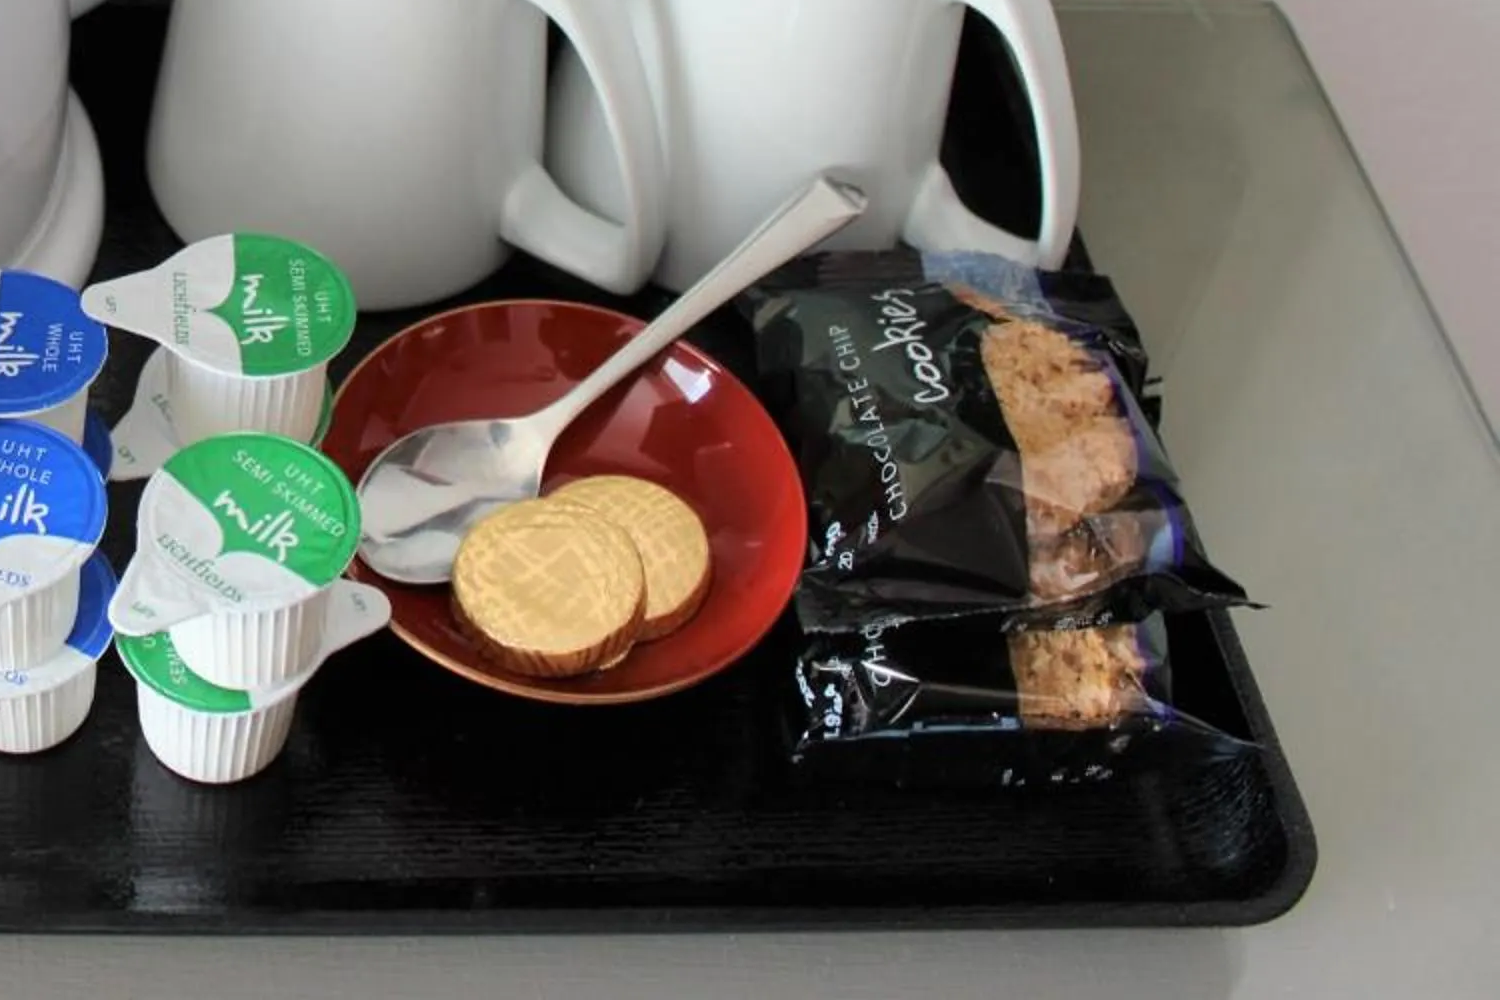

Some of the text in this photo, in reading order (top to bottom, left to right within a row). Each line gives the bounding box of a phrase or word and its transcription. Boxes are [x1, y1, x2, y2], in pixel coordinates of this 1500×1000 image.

[241, 273, 291, 346] milk
[288, 258, 312, 357] SEMI SKIMMED
[314, 290, 332, 325] UHT
[41, 322, 64, 374] WHOLE
[67, 330, 85, 364] UHT
[870, 287, 950, 404] cookies
[2, 439, 47, 462] UHT
[828, 324, 908, 521] CHOCOLATE CHIP
[232, 449, 346, 538] SEMI SKIMMED
[284, 462, 325, 495] UHT
[213, 489, 300, 563] milk
